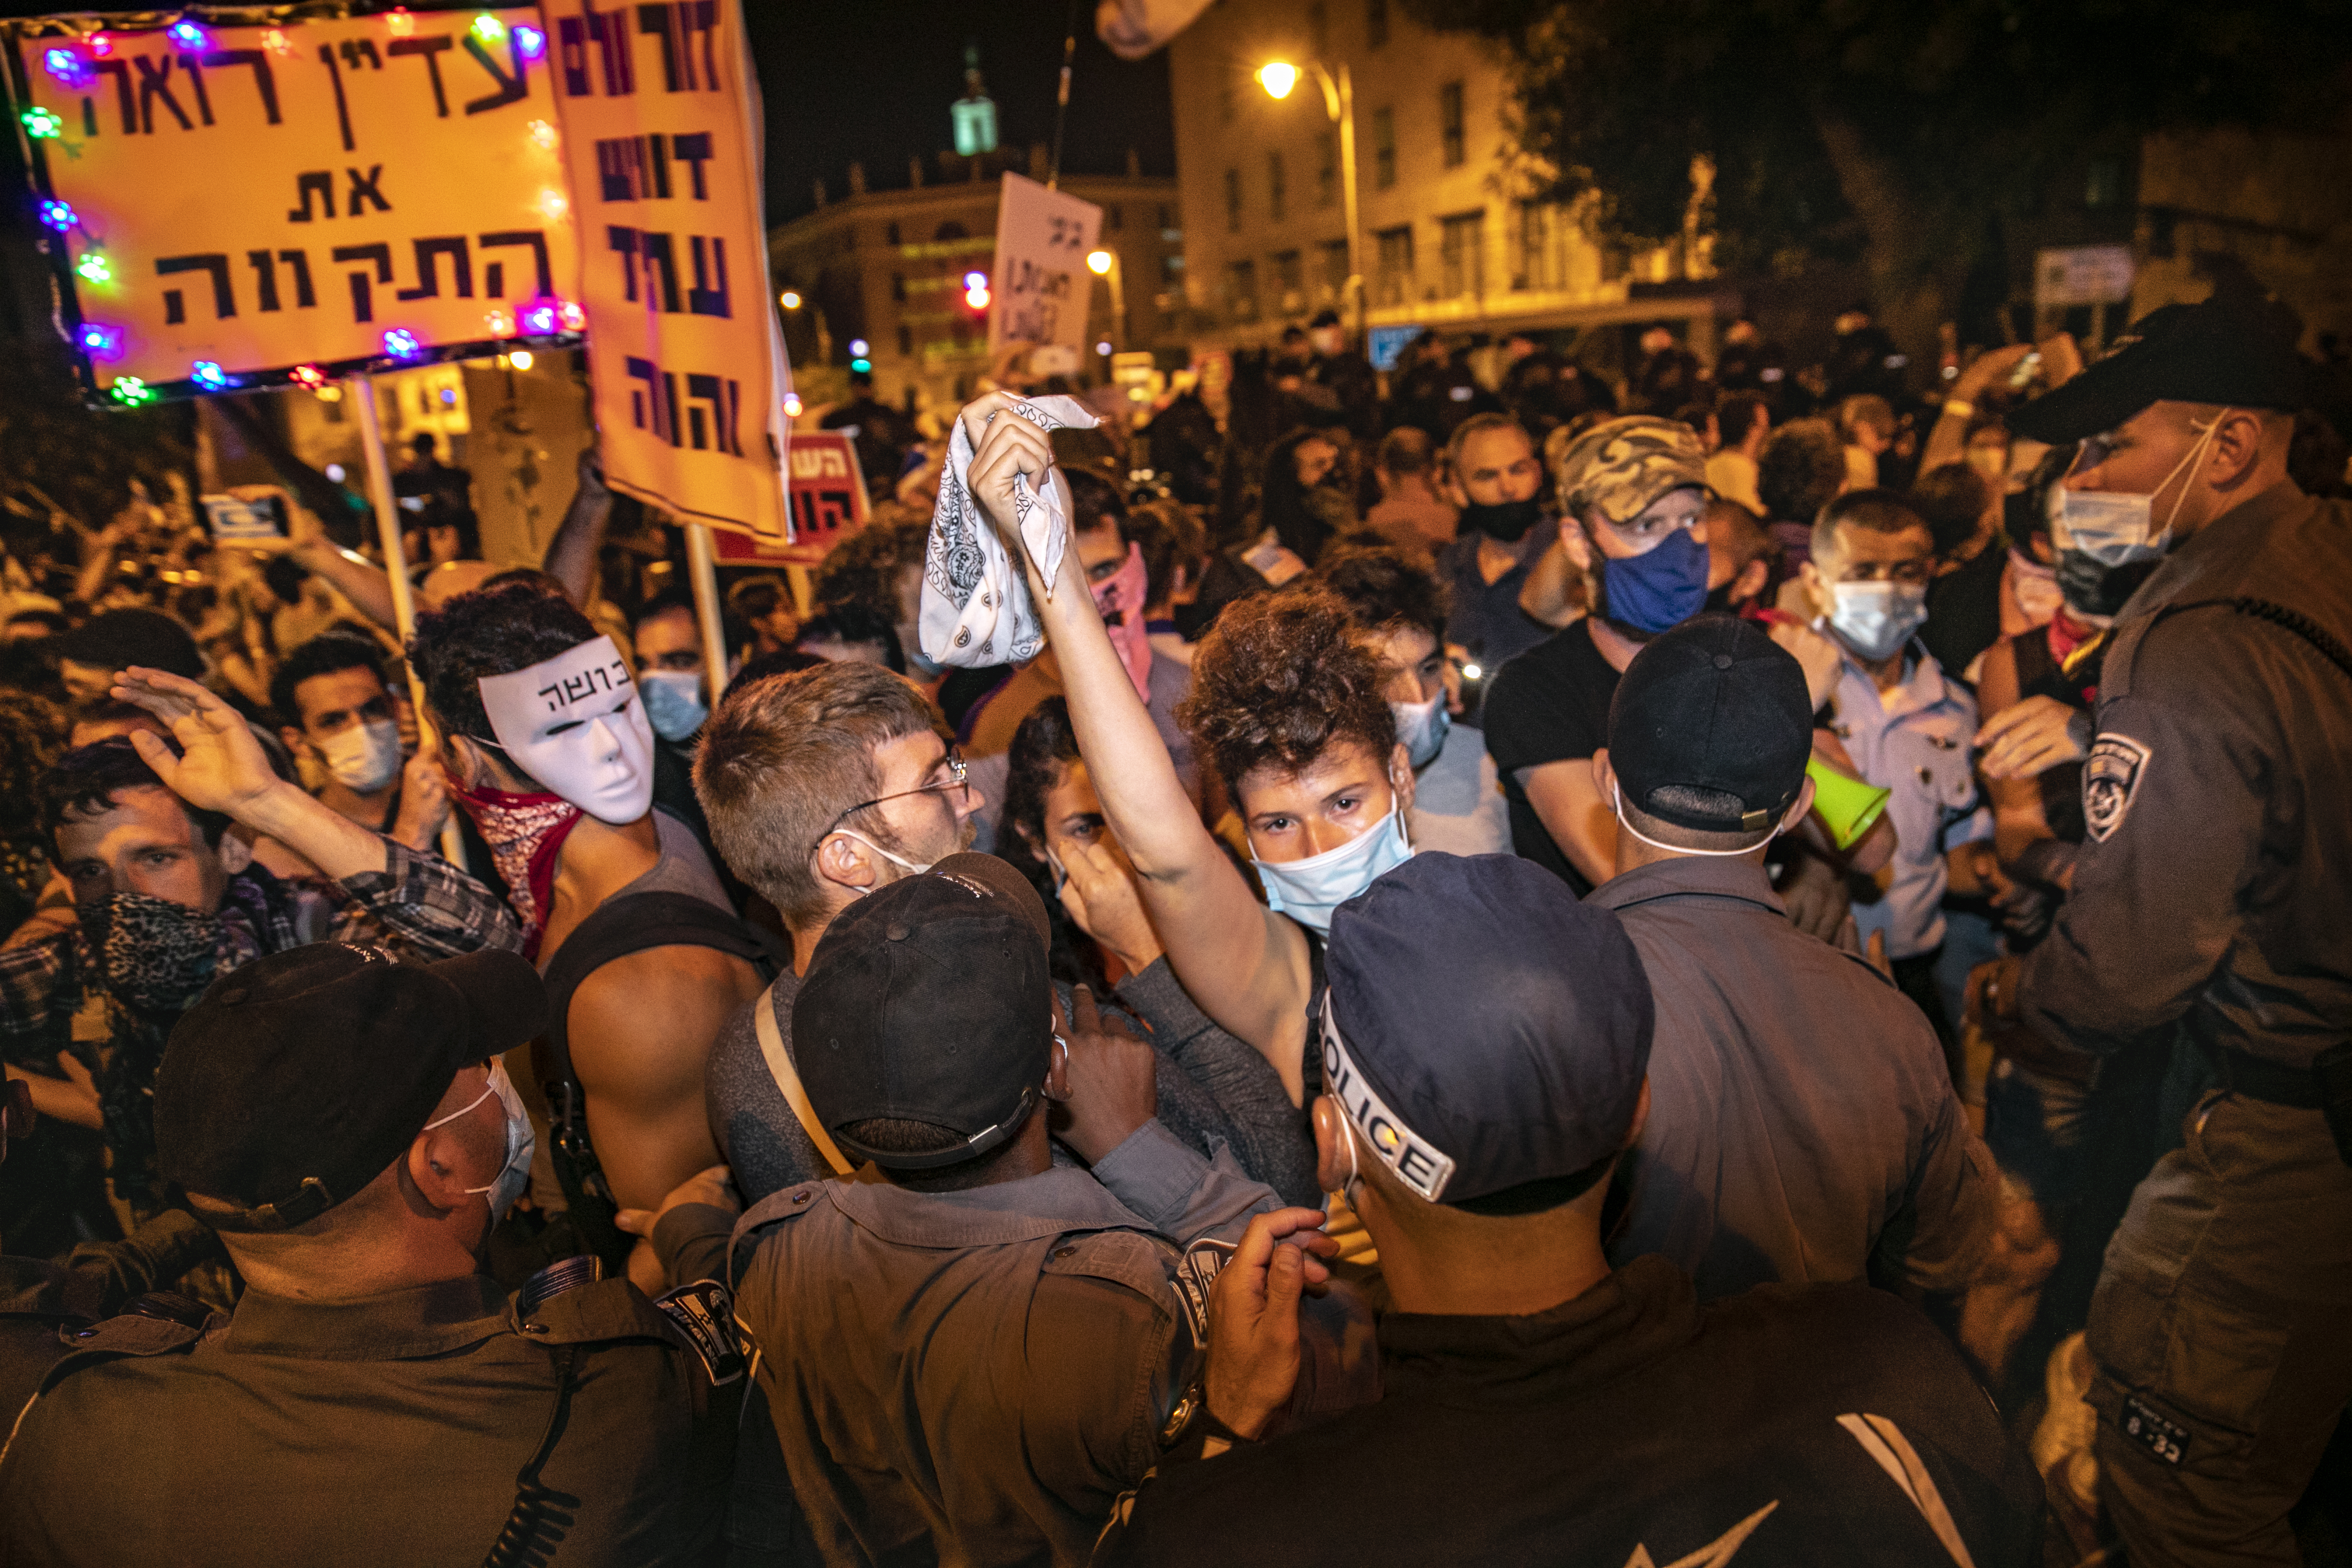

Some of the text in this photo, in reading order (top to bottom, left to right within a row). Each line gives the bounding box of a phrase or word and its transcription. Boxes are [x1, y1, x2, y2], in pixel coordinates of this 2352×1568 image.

[76, 31, 529, 152] עדיין רואה
[288, 164, 392, 223] את
[155, 230, 554, 325] התקווה
[538, 659, 631, 711] בושה
[1324, 1035, 1436, 1189] OLICE
